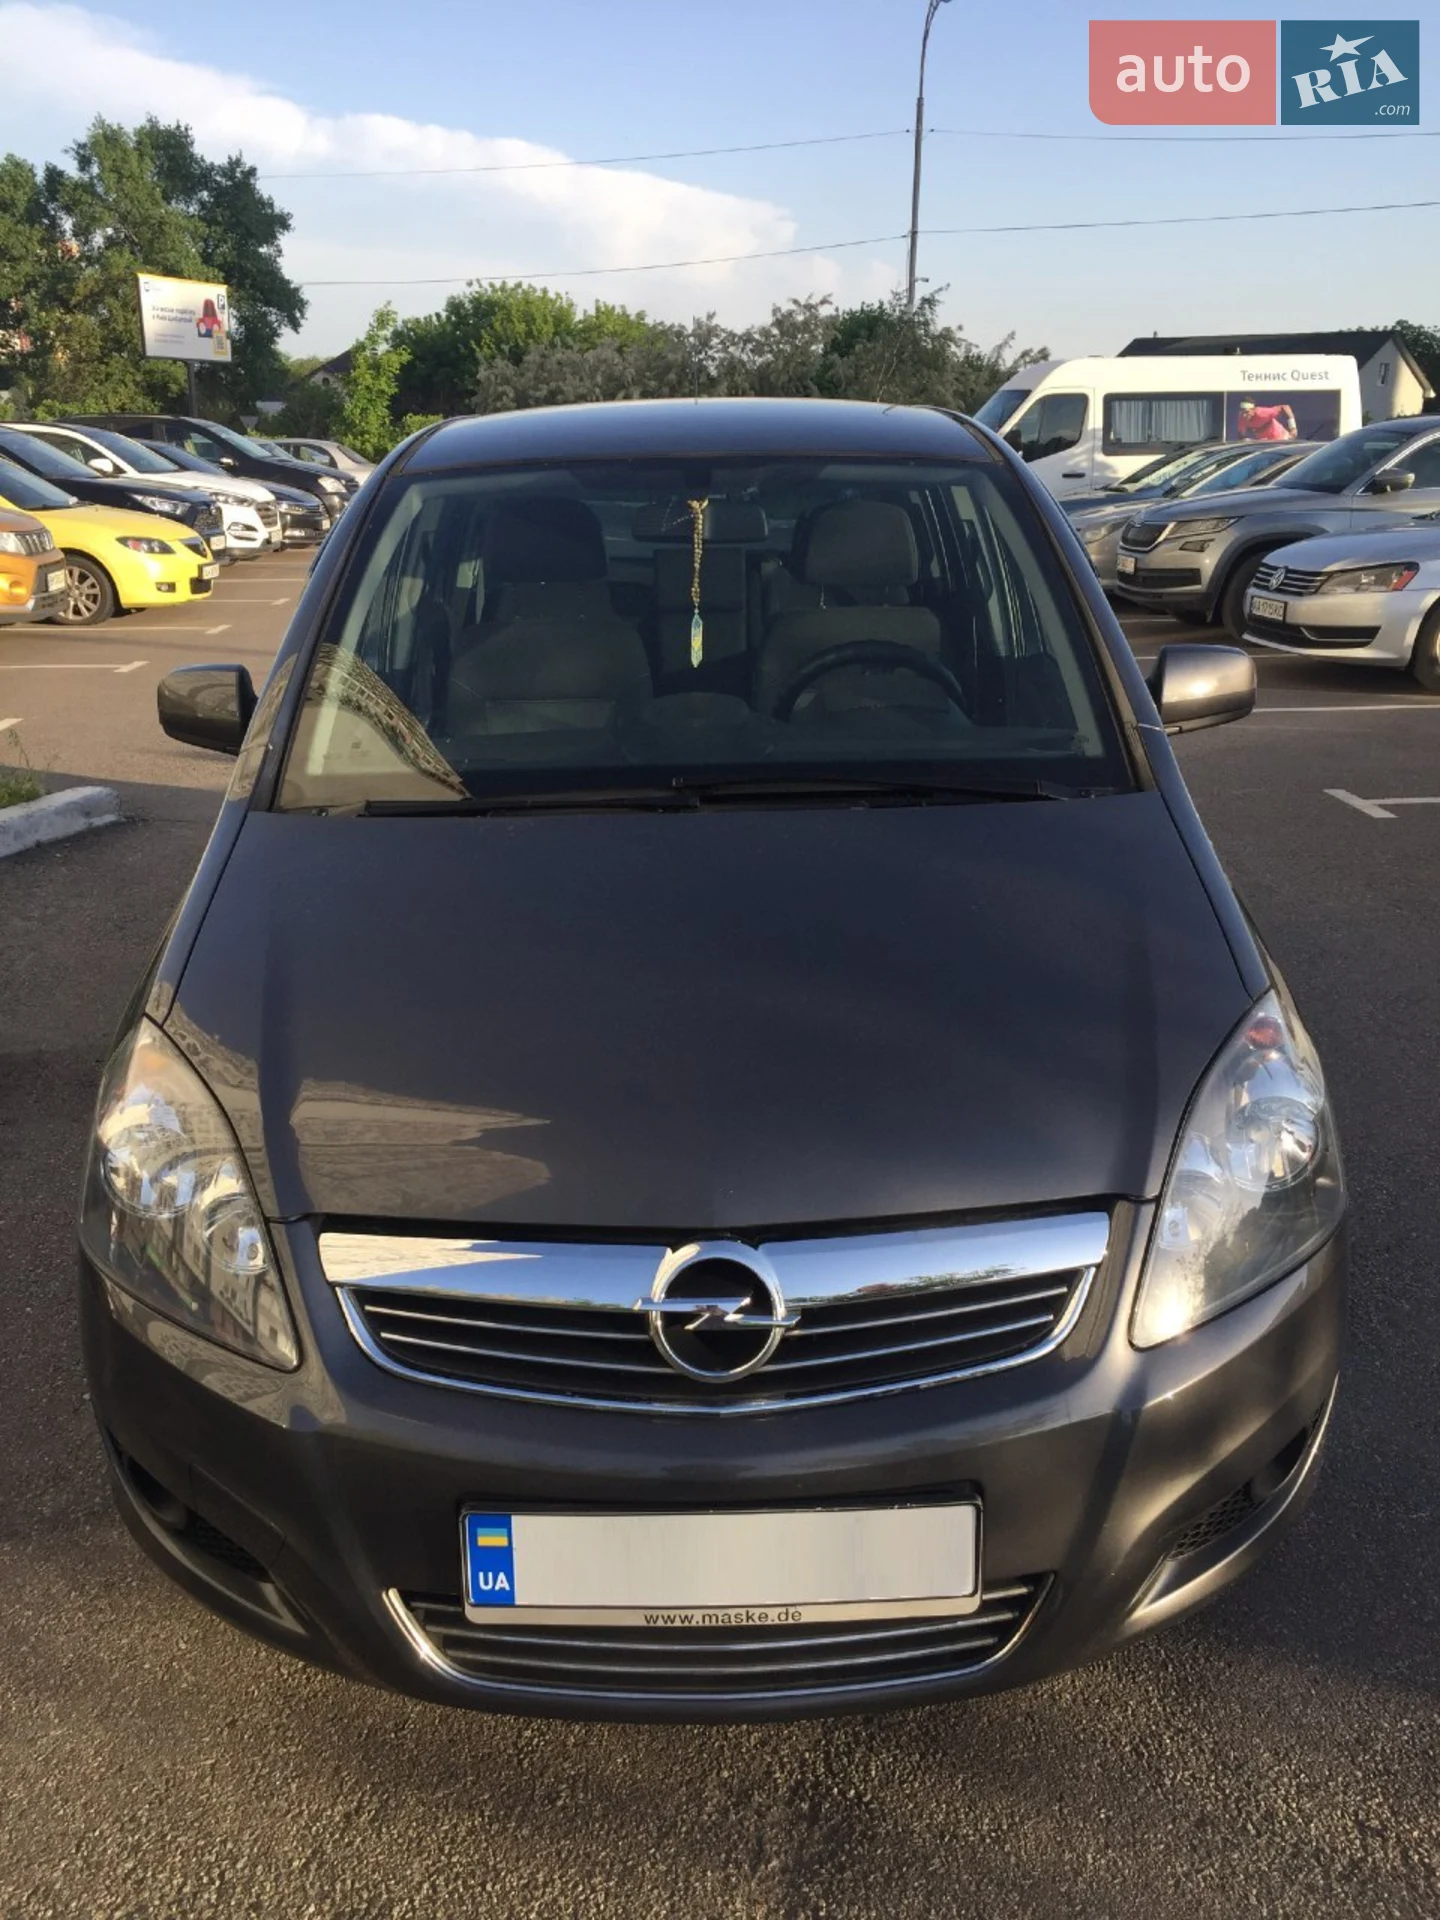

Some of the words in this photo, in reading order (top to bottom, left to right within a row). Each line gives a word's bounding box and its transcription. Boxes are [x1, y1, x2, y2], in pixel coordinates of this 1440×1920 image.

[1240, 369, 1287, 382] Теннис
[1290, 369, 1330, 382] Quest
[478, 1571, 511, 1591] UA
[644, 1607, 802, 1625] www.maske.de
